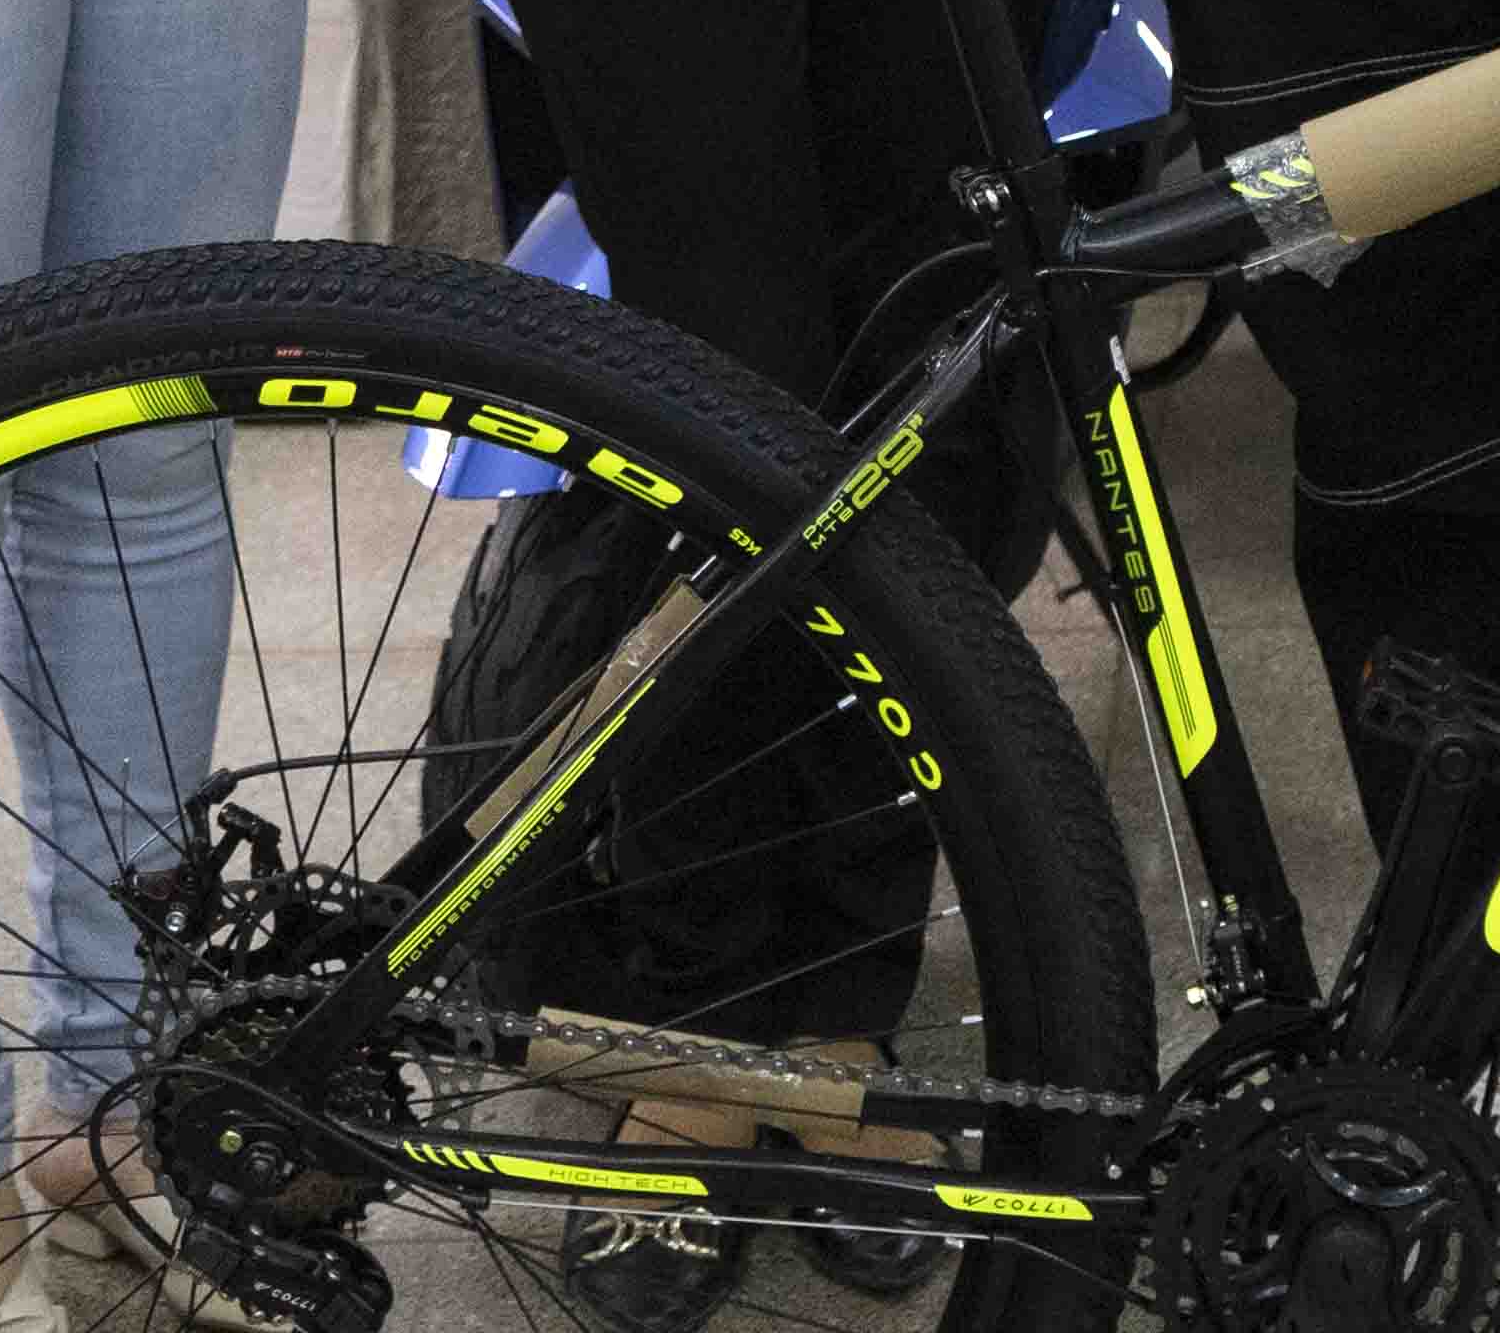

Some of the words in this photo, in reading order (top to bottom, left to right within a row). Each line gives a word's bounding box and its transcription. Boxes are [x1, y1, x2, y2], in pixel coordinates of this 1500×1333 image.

[257, 379, 685, 510] aero
[809, 509, 855, 552] MTB
[1085, 409, 1157, 615] NANTES
[727, 526, 764, 557] KES
[993, 1199, 1068, 1215] COLLI
